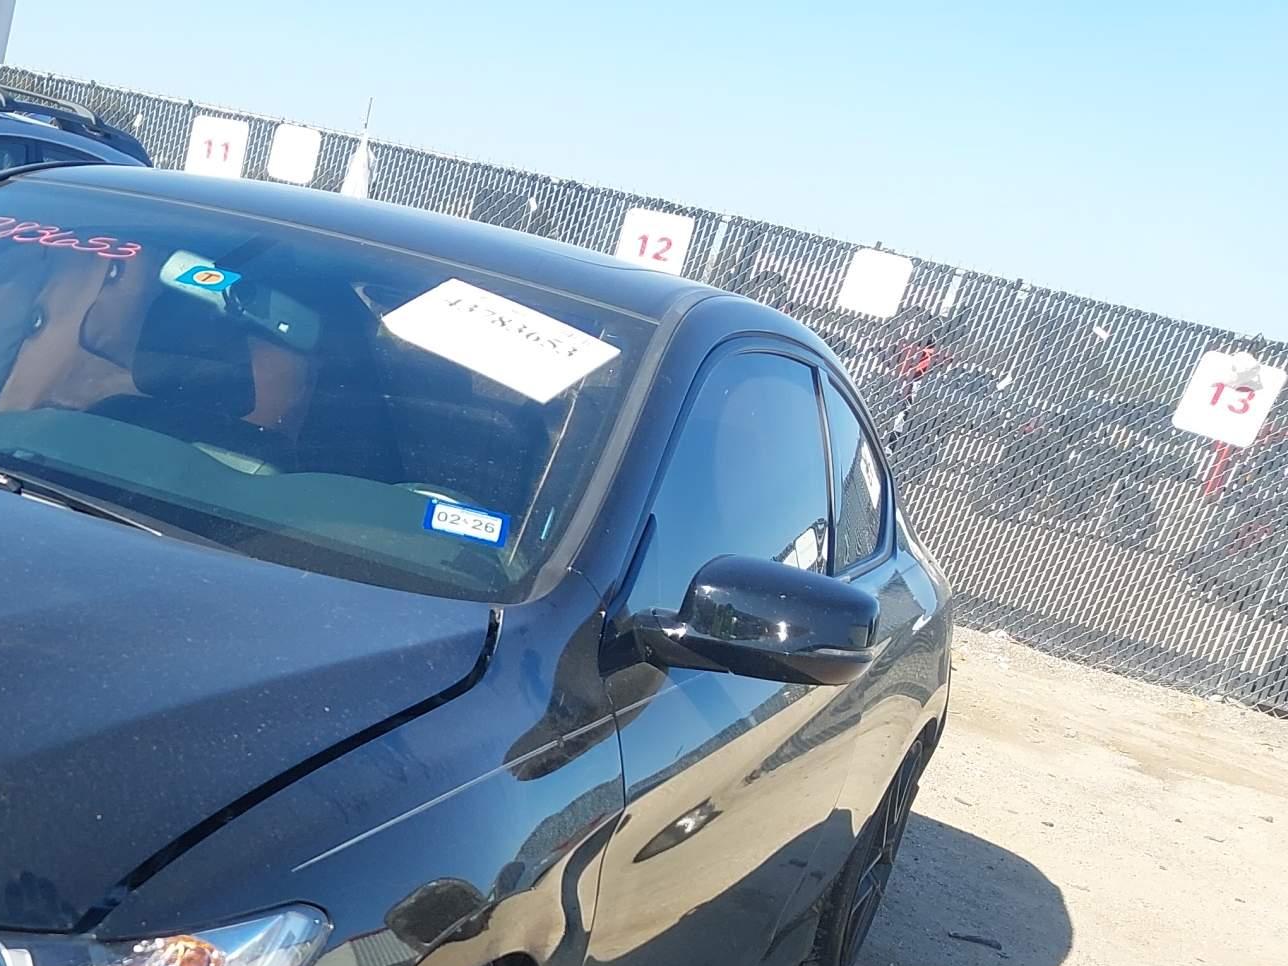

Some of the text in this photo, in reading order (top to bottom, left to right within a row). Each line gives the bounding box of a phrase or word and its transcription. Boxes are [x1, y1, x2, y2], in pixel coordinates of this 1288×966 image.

[204, 139, 229, 162] 11
[638, 234, 673, 261] 12
[1211, 382, 1255, 414] 13
